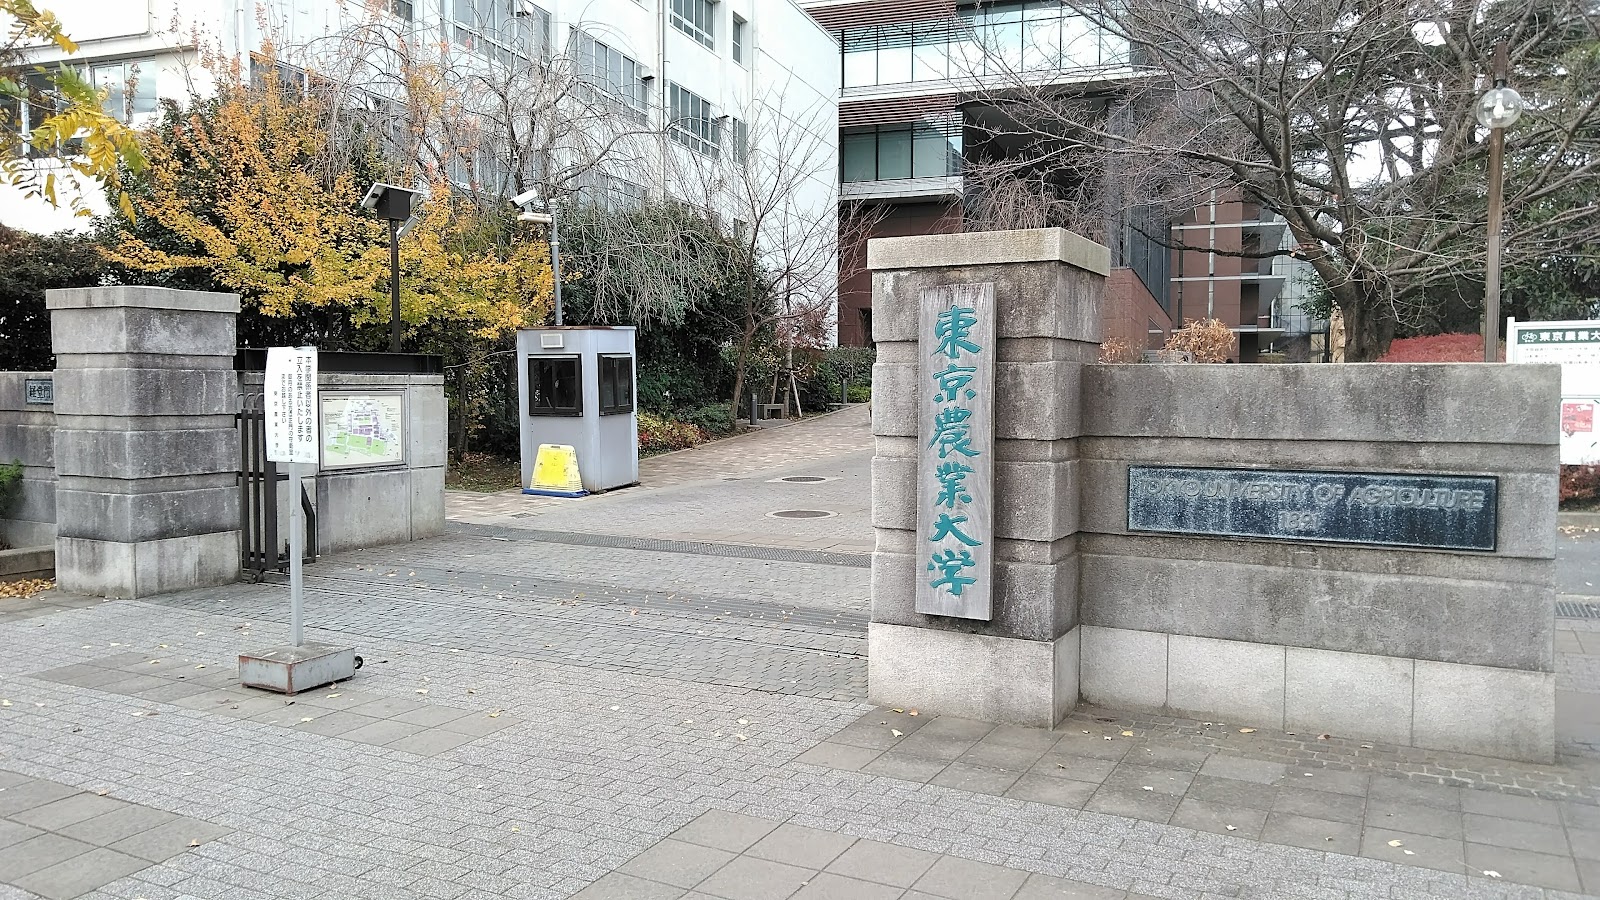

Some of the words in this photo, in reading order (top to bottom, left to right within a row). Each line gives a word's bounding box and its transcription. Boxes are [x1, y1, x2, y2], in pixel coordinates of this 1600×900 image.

[296, 356, 304, 443] 立入を禁止いたします
[305, 356, 313, 443] 本学関係者以外の者の
[926, 304, 984, 597] 東京農業大学
[1139, 478, 1201, 498] TOKYO
[1204, 481, 1308, 503] UNIVERSITY
[1312, 483, 1346, 504] OF
[1348, 485, 1486, 511] AGRICULTURE
[1278, 510, 1321, 530] 1891
